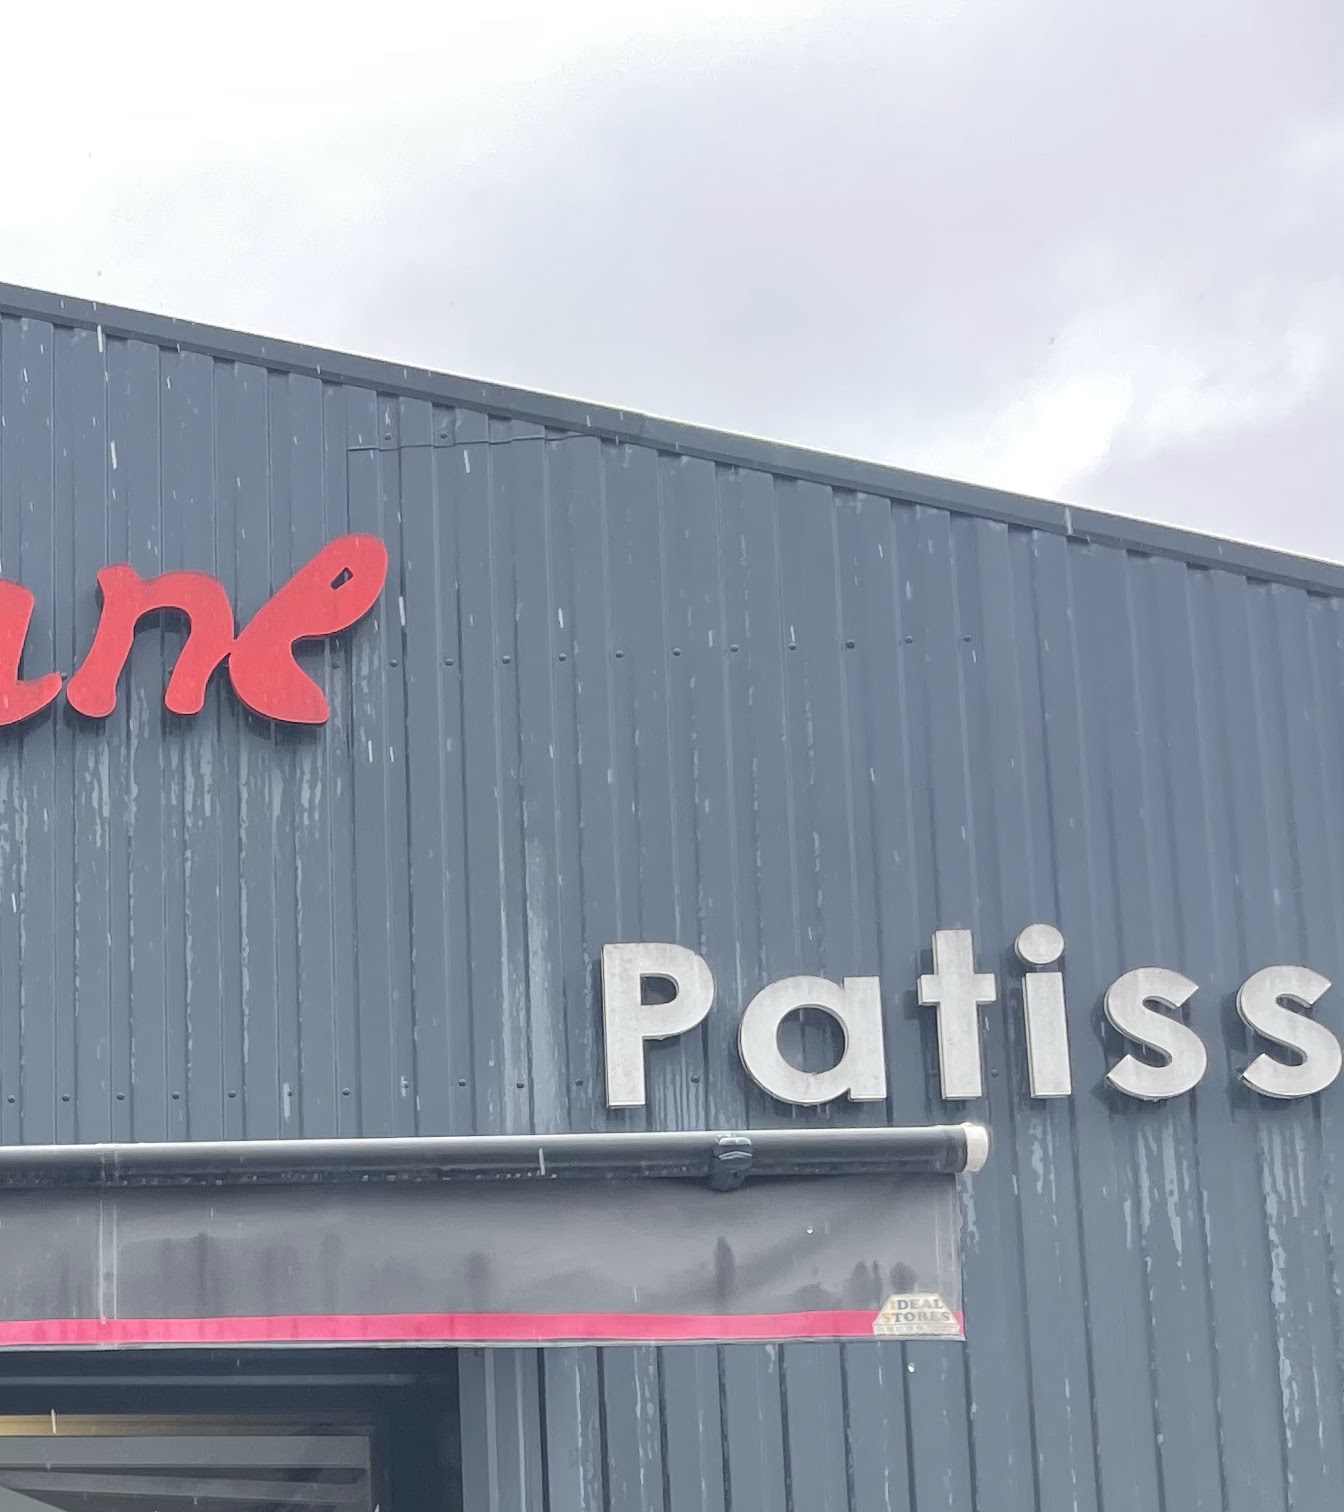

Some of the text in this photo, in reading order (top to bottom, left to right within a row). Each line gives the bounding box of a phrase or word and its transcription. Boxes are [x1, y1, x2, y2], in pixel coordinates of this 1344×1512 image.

[600, 922, 1344, 1110] Patiss
[889, 1298, 944, 1311] IDEAL
[880, 1311, 951, 1324] STORES
